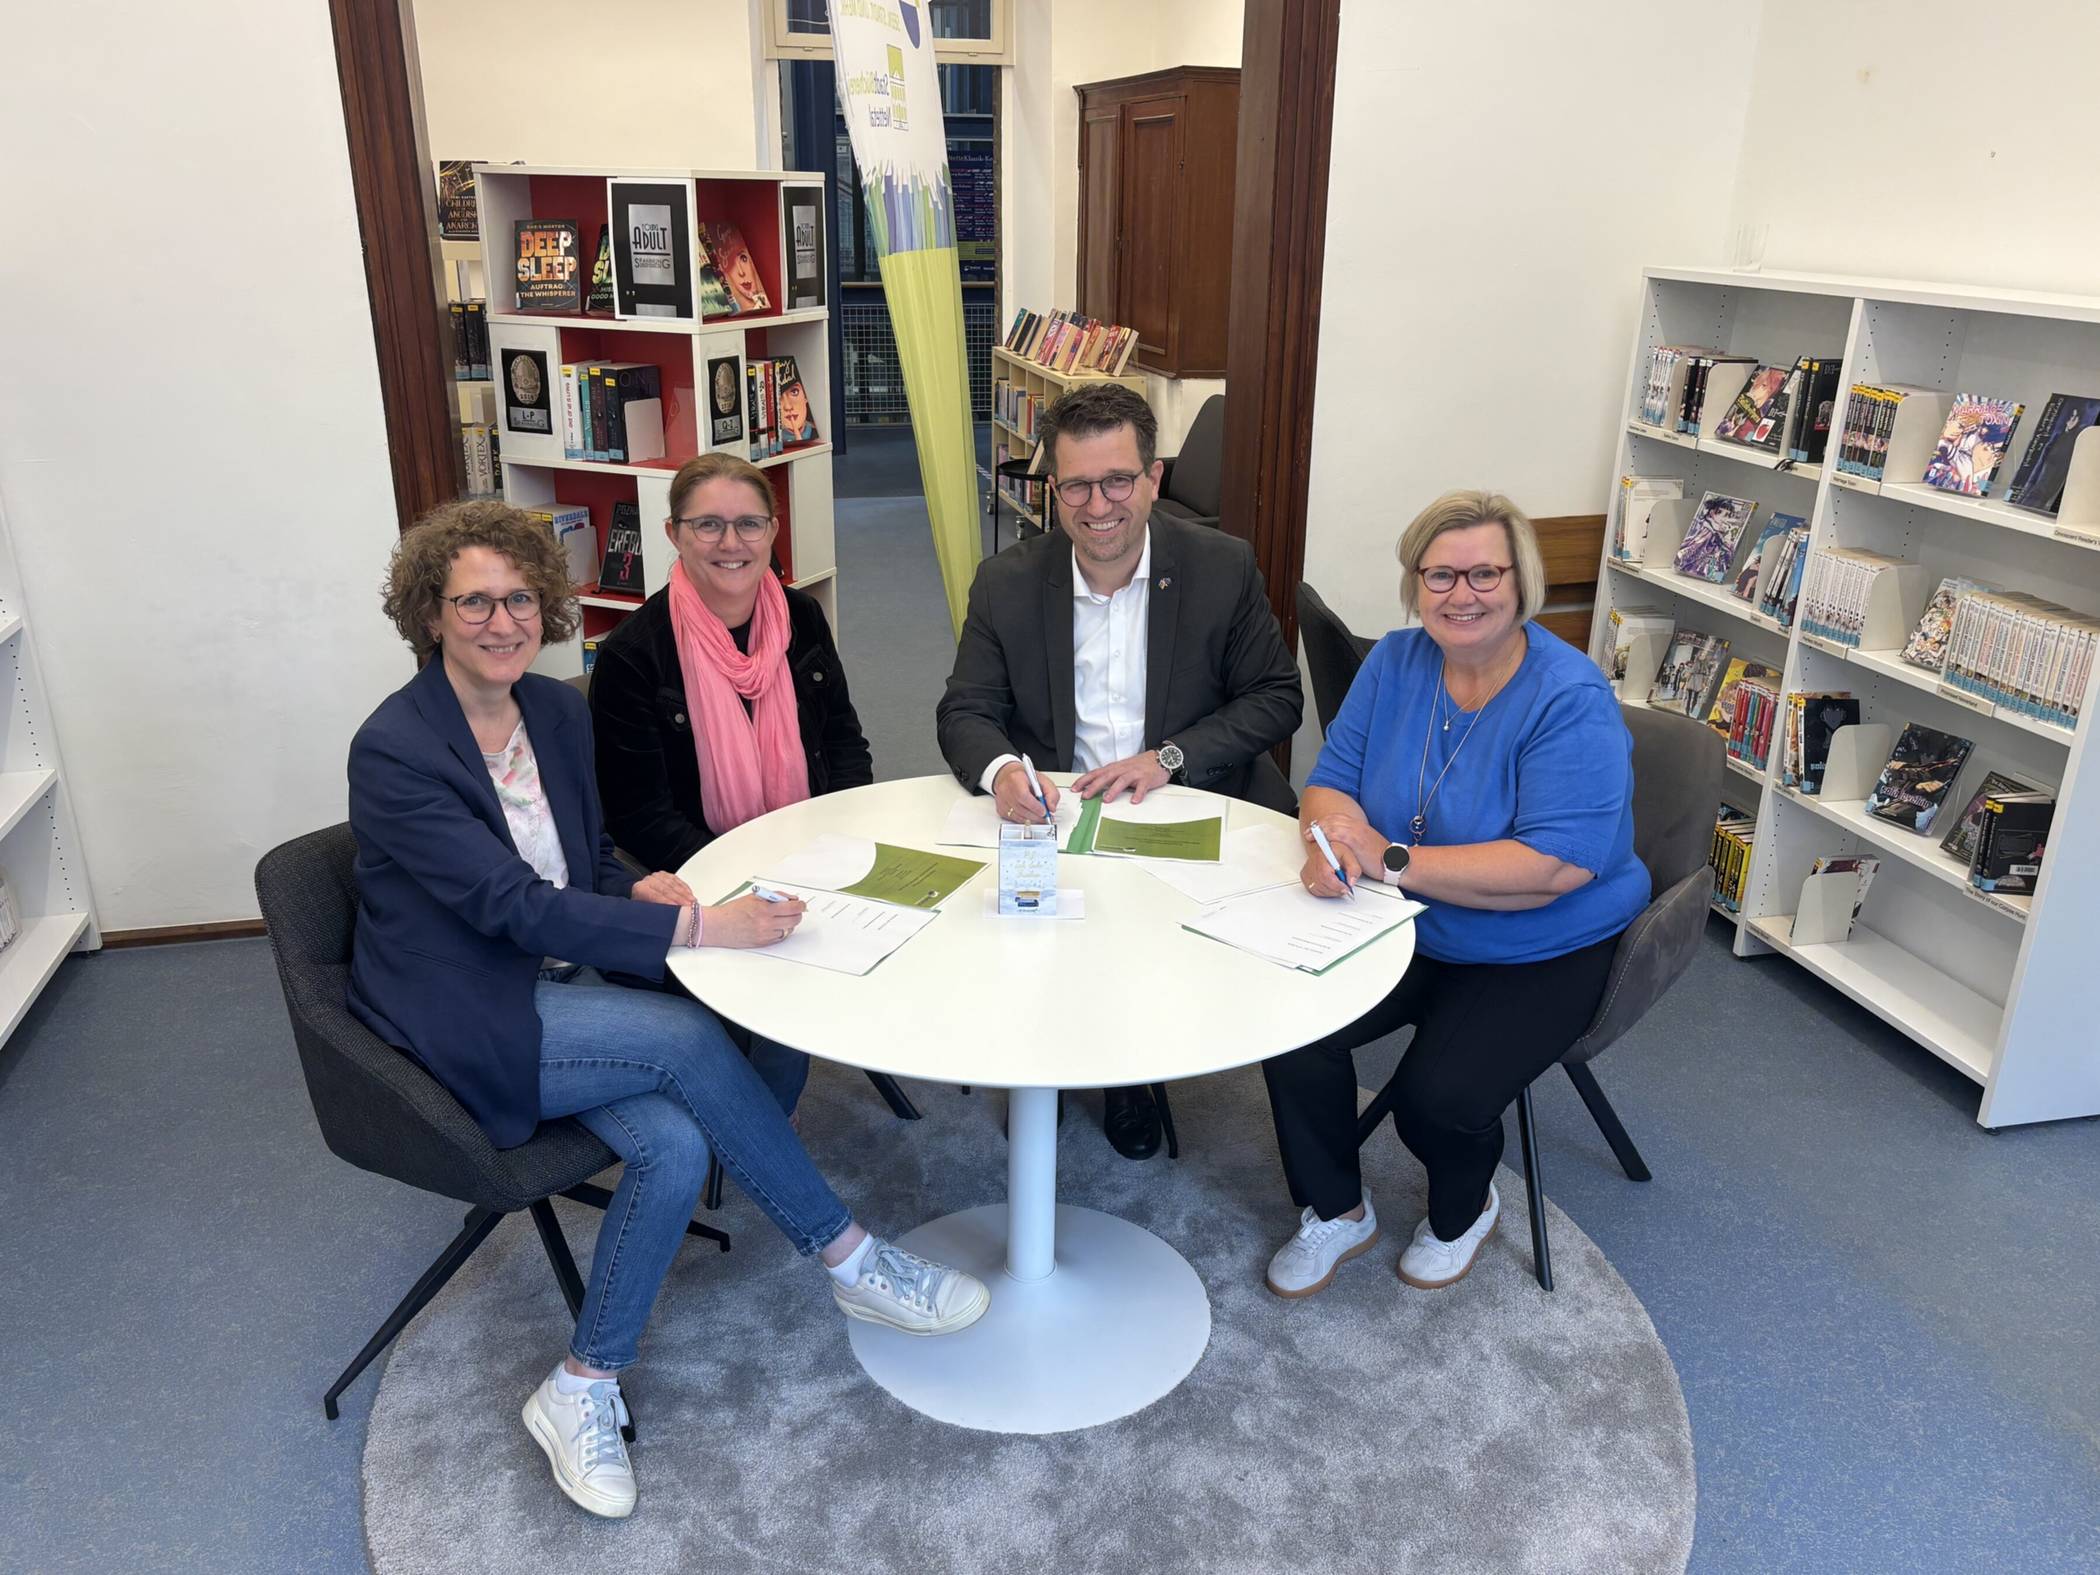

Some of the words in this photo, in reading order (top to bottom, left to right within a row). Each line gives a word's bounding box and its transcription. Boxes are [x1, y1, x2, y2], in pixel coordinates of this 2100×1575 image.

[520, 231, 573, 257] DEEP
[632, 226, 668, 250] ADULT
[517, 257, 577, 282] SLEEP
[1980, 412, 2012, 425] TOXIN
[476, 438, 486, 479] VORTEX
[608, 529, 643, 556] EREBO
[620, 551, 633, 581] 3
